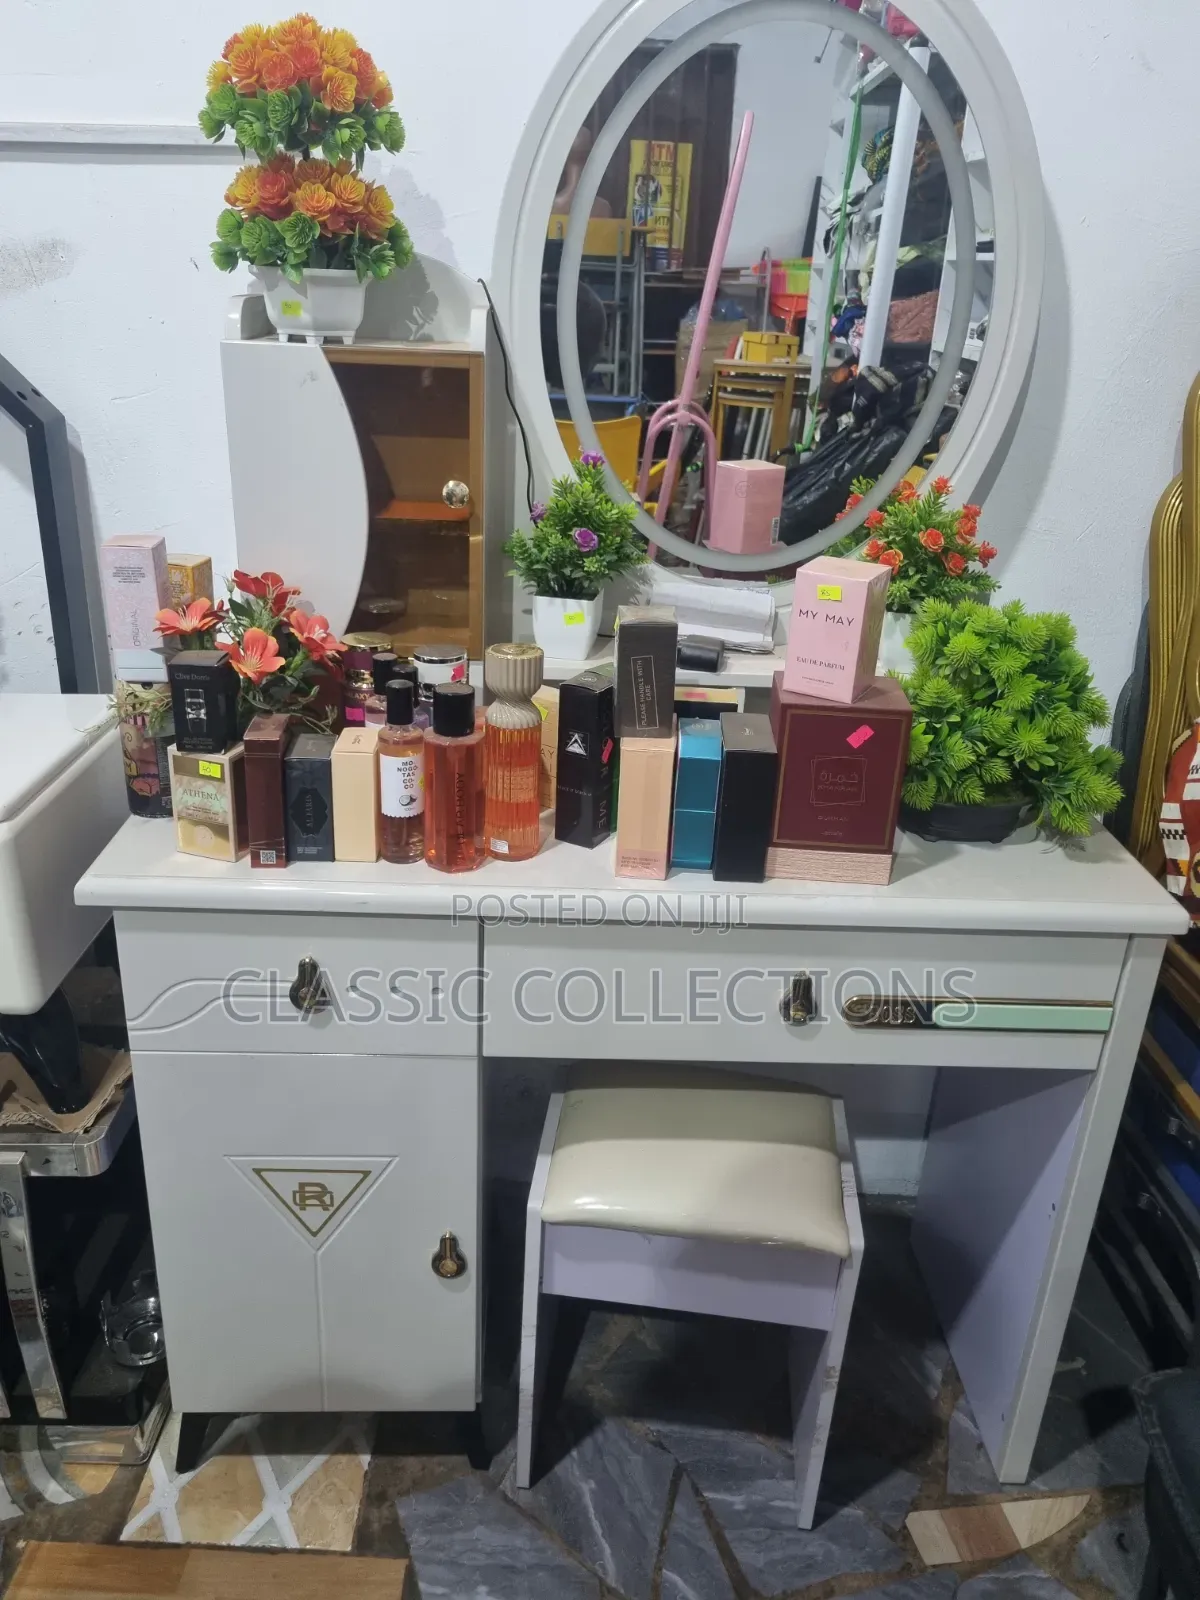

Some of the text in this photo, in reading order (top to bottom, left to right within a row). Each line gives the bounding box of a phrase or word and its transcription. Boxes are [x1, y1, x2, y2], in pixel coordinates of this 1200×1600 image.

[798, 608, 855, 627] MY MAY
[819, 660, 845, 671] PARFUM
[639, 702, 647, 726] PLEASE
[182, 788, 220, 802] ATHENA
